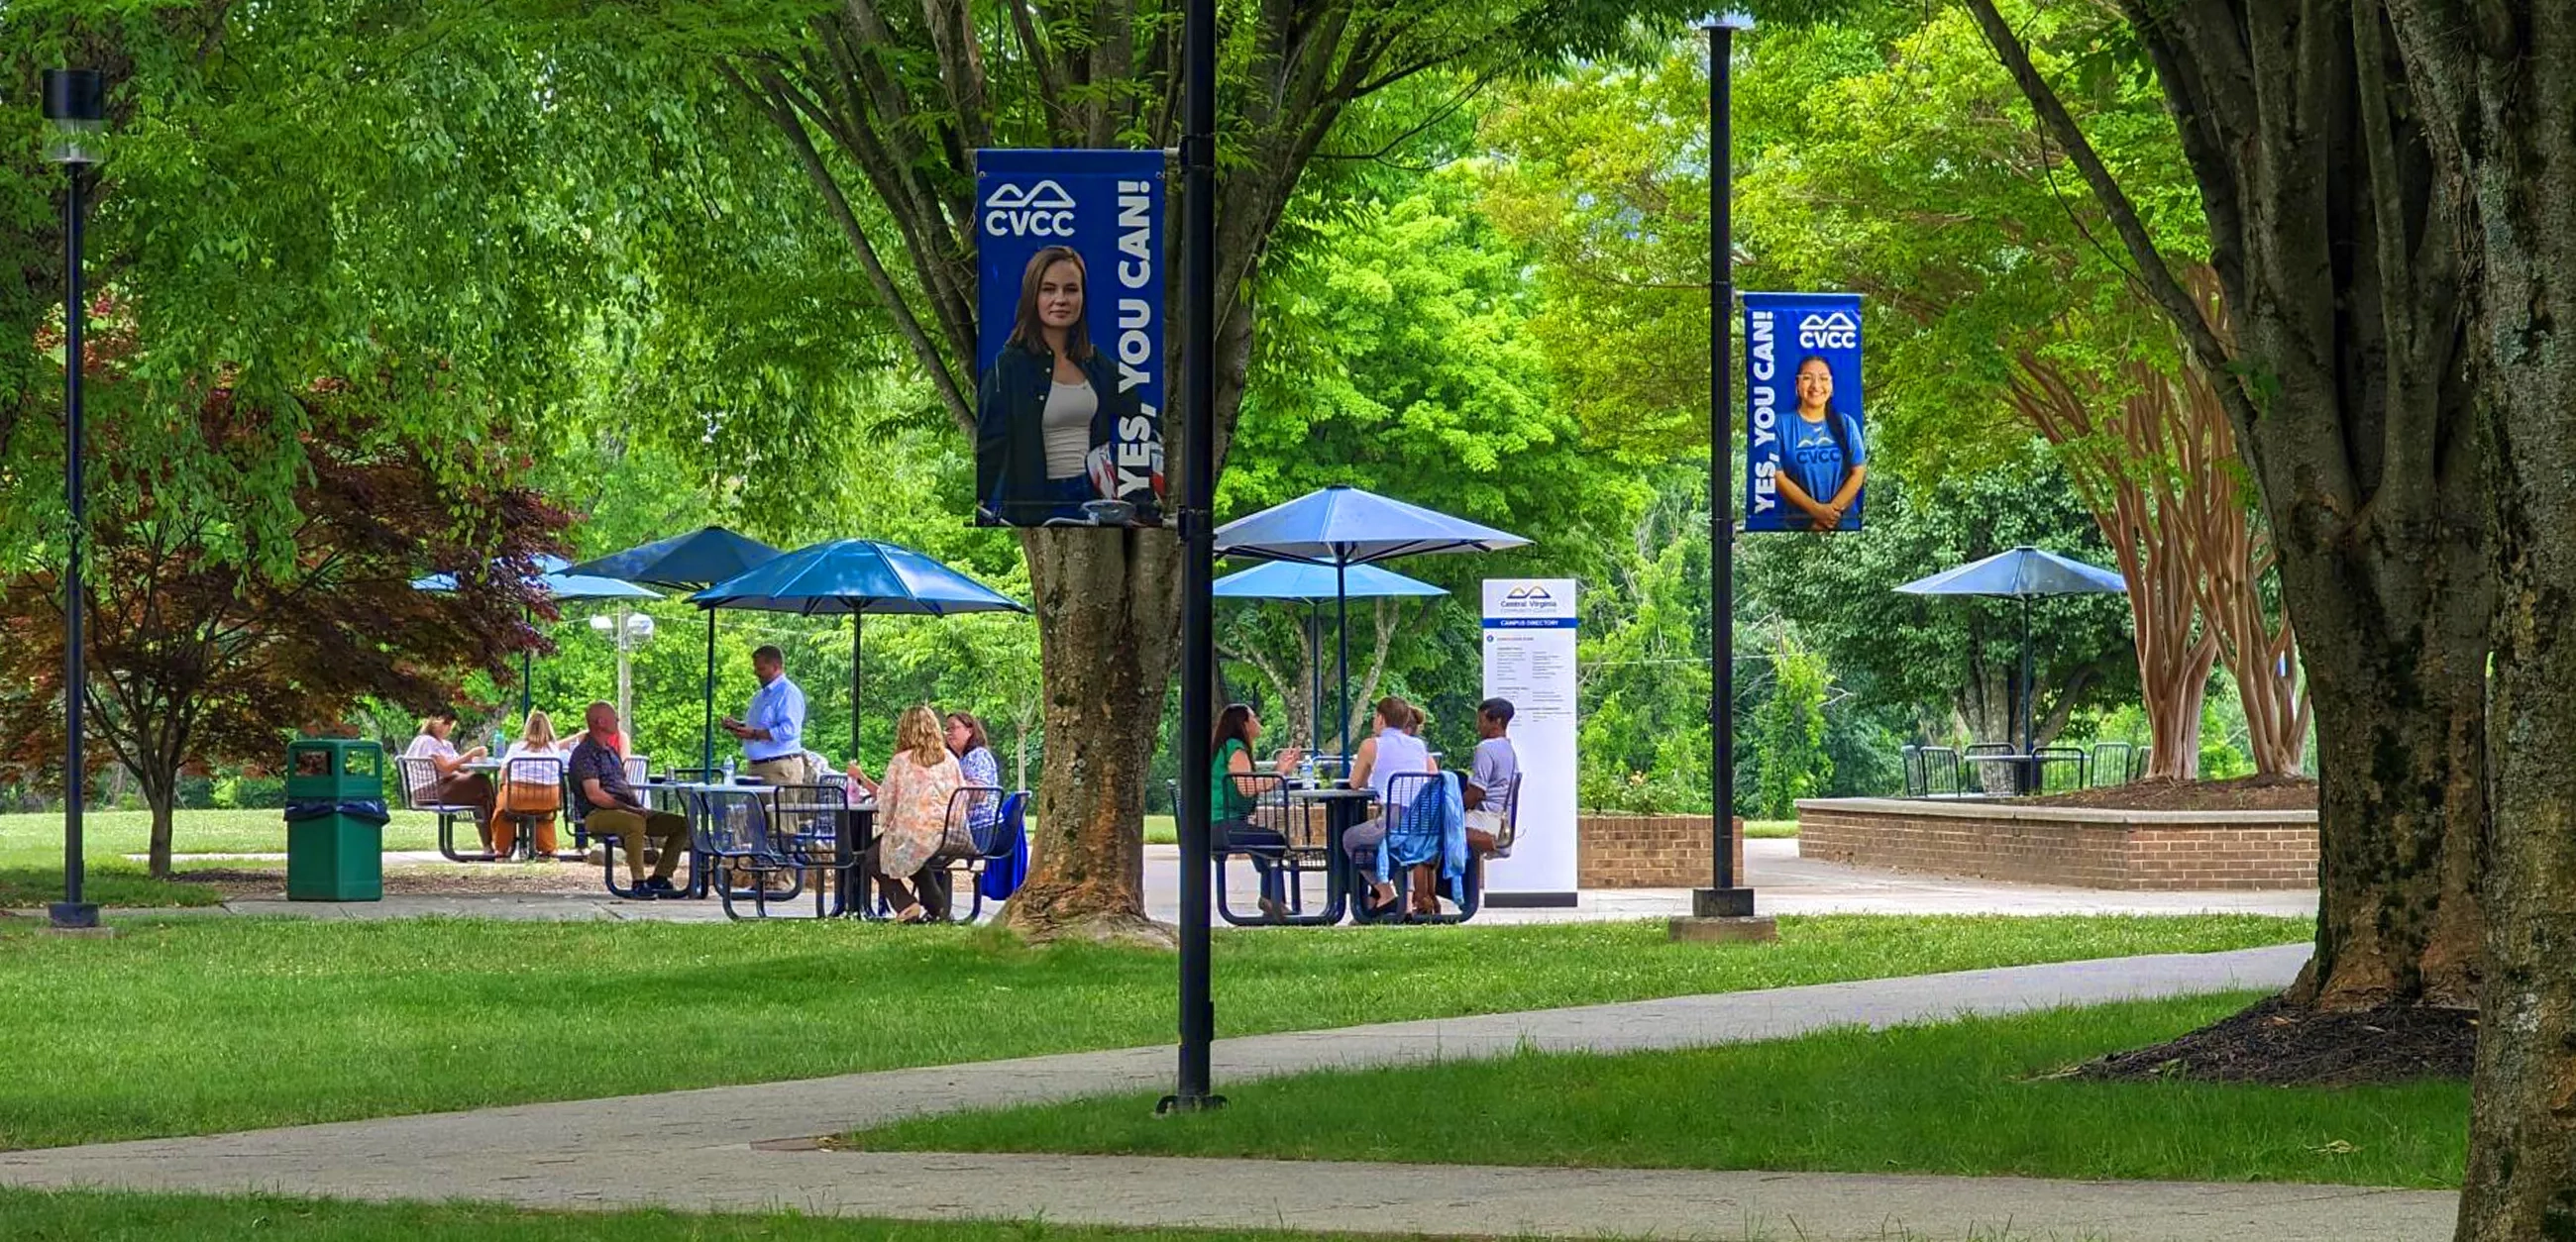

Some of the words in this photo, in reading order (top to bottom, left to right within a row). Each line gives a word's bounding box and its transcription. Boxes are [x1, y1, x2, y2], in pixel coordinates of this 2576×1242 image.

[985, 210, 1076, 237] CVCC
[1118, 180, 1151, 289] CAN!
[1118, 298, 1151, 393] YOU
[1752, 311, 1775, 381] CAN!
[1799, 332, 1857, 349] CVCC
[1754, 387, 1775, 447] YOU
[1118, 402, 1157, 499] YES,
[1796, 450, 1841, 465] CVCC
[1755, 453, 1780, 514] YES,
